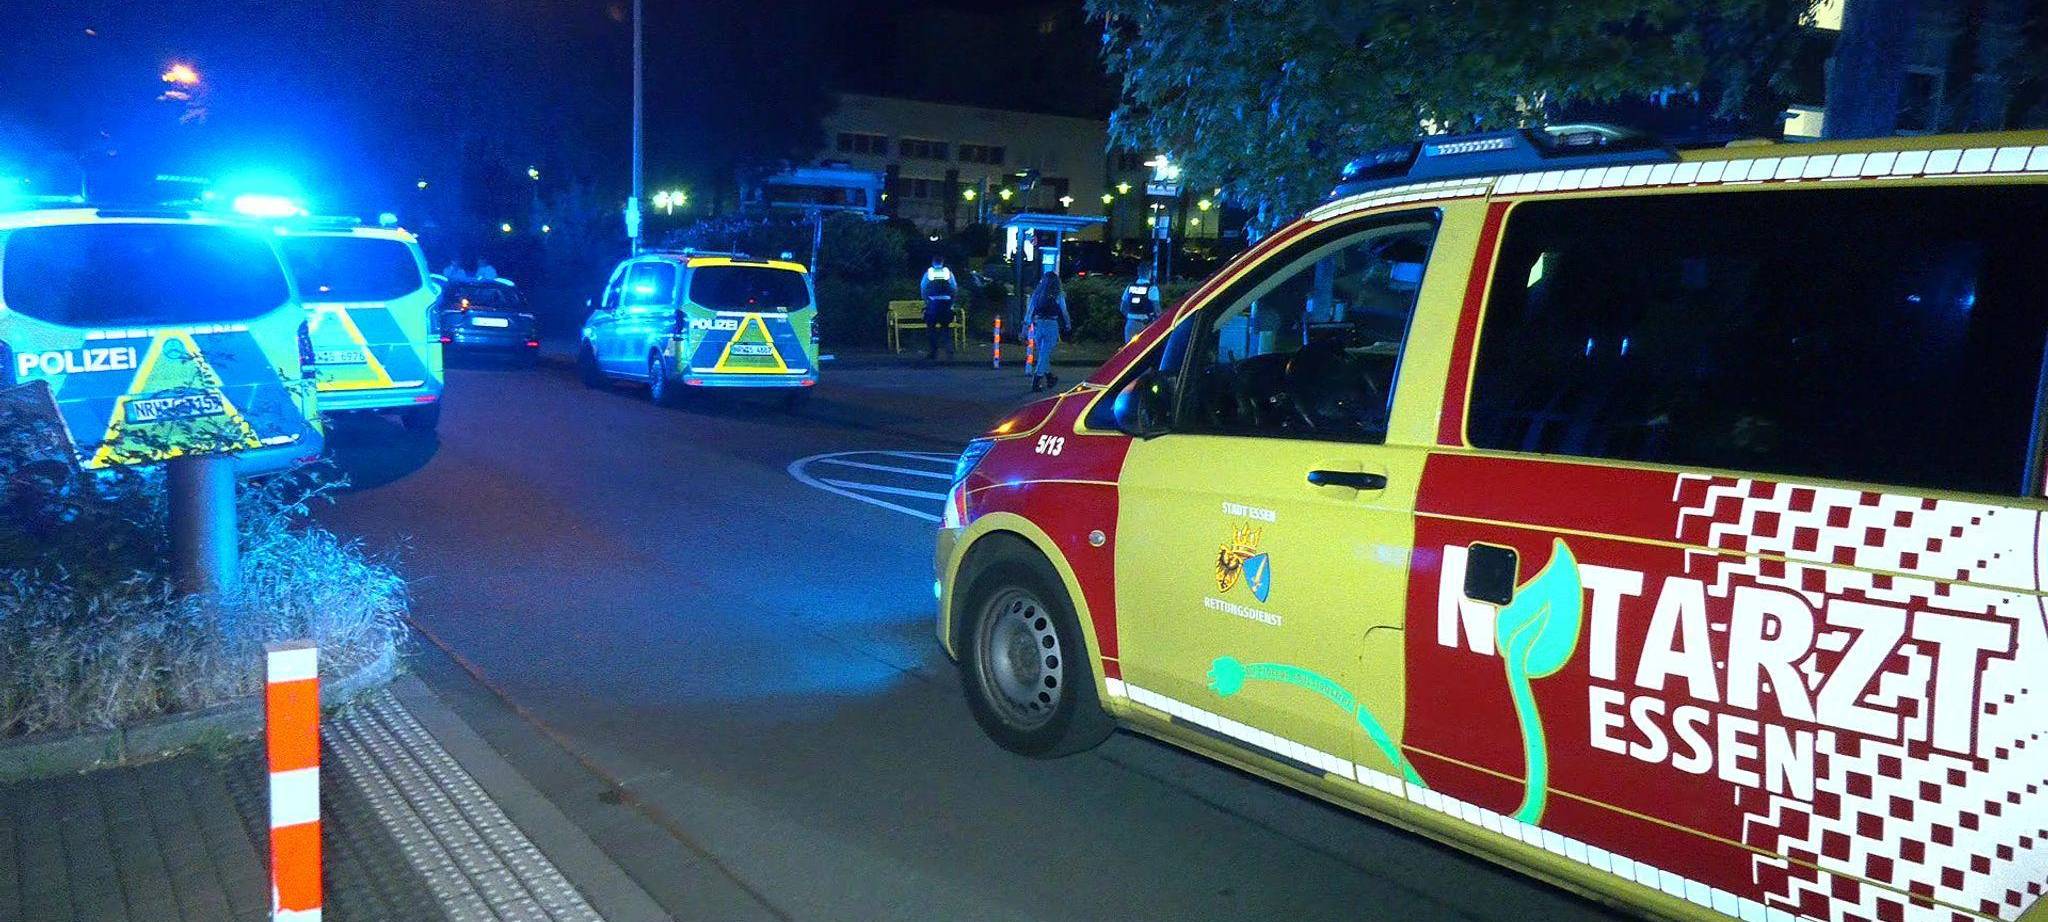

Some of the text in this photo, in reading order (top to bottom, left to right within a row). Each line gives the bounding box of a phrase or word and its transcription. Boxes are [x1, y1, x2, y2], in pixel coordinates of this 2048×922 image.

[690, 318, 738, 331] POLIZEI
[17, 346, 137, 376] POLIZEI
[1035, 434, 1065, 456] 5/13
[1222, 501, 1276, 523] STADT ESSEN
[1204, 596, 1283, 626] RETTUNGSDIENST
[1437, 544, 2014, 755] NTARZT
[1588, 685, 1816, 801] ESSEN
